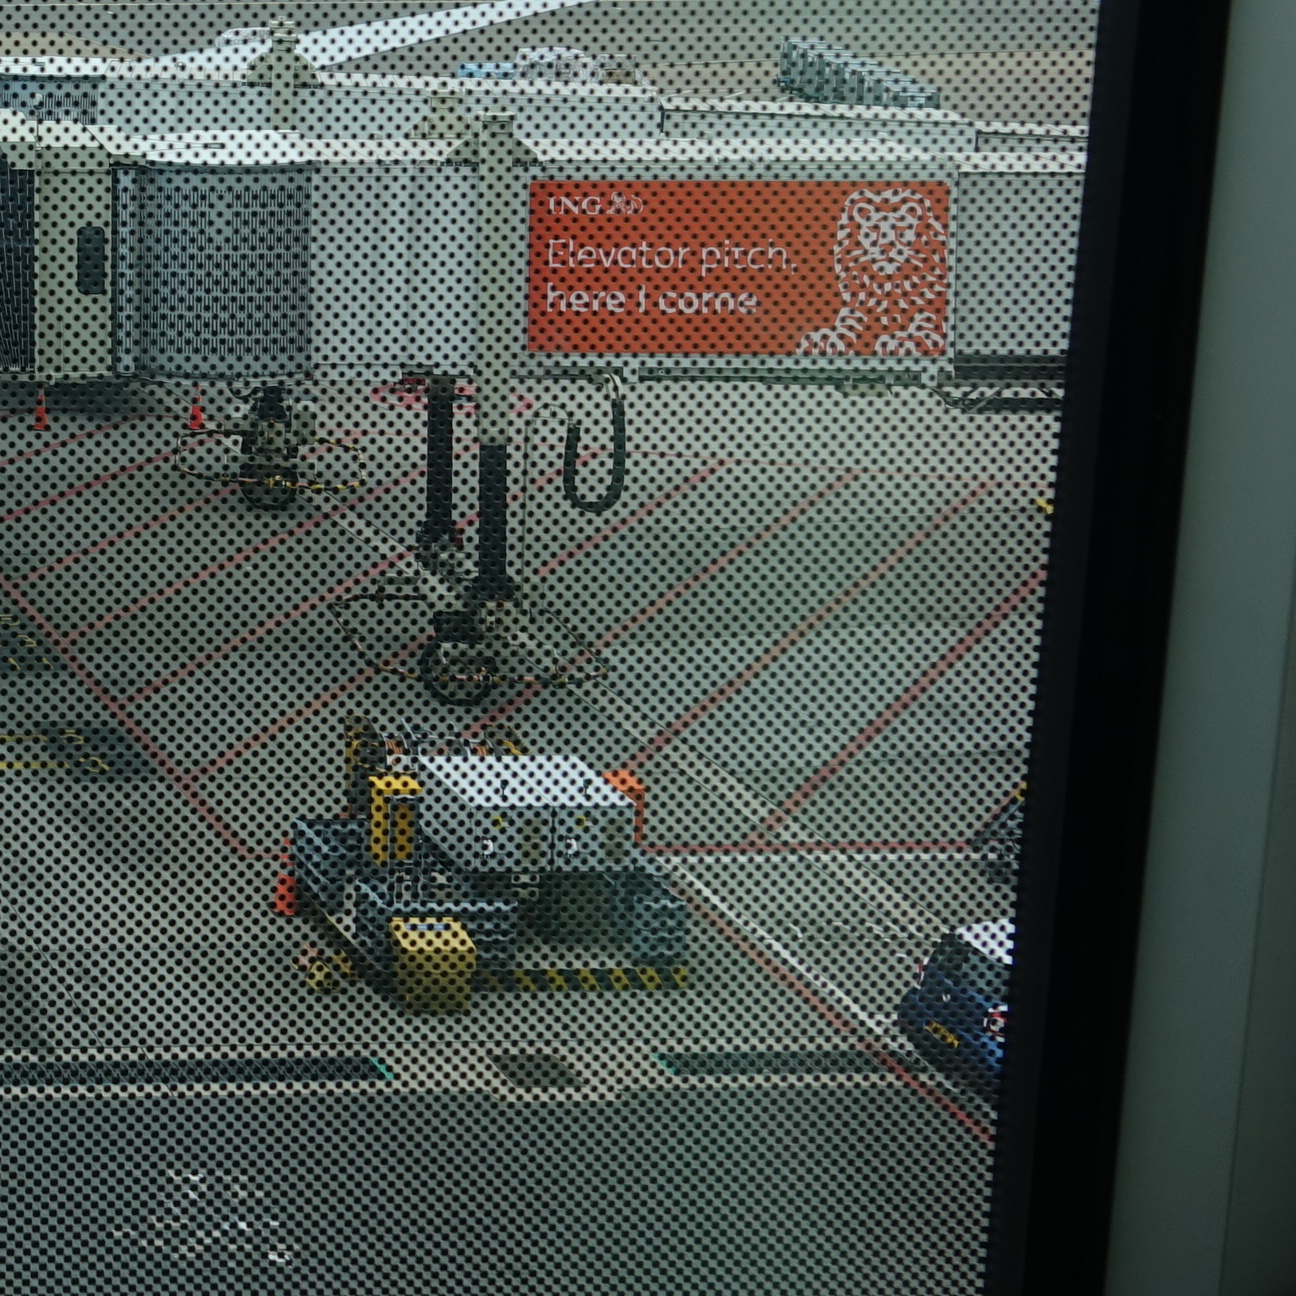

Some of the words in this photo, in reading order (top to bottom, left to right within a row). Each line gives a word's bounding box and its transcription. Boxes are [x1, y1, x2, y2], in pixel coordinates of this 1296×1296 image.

[549, 196, 602, 215] ING
[548, 238, 691, 269] Elevator
[702, 239, 797, 277] pitch,
[546, 282, 626, 313] here
[638, 284, 647, 313] I
[659, 291, 758, 314] come
